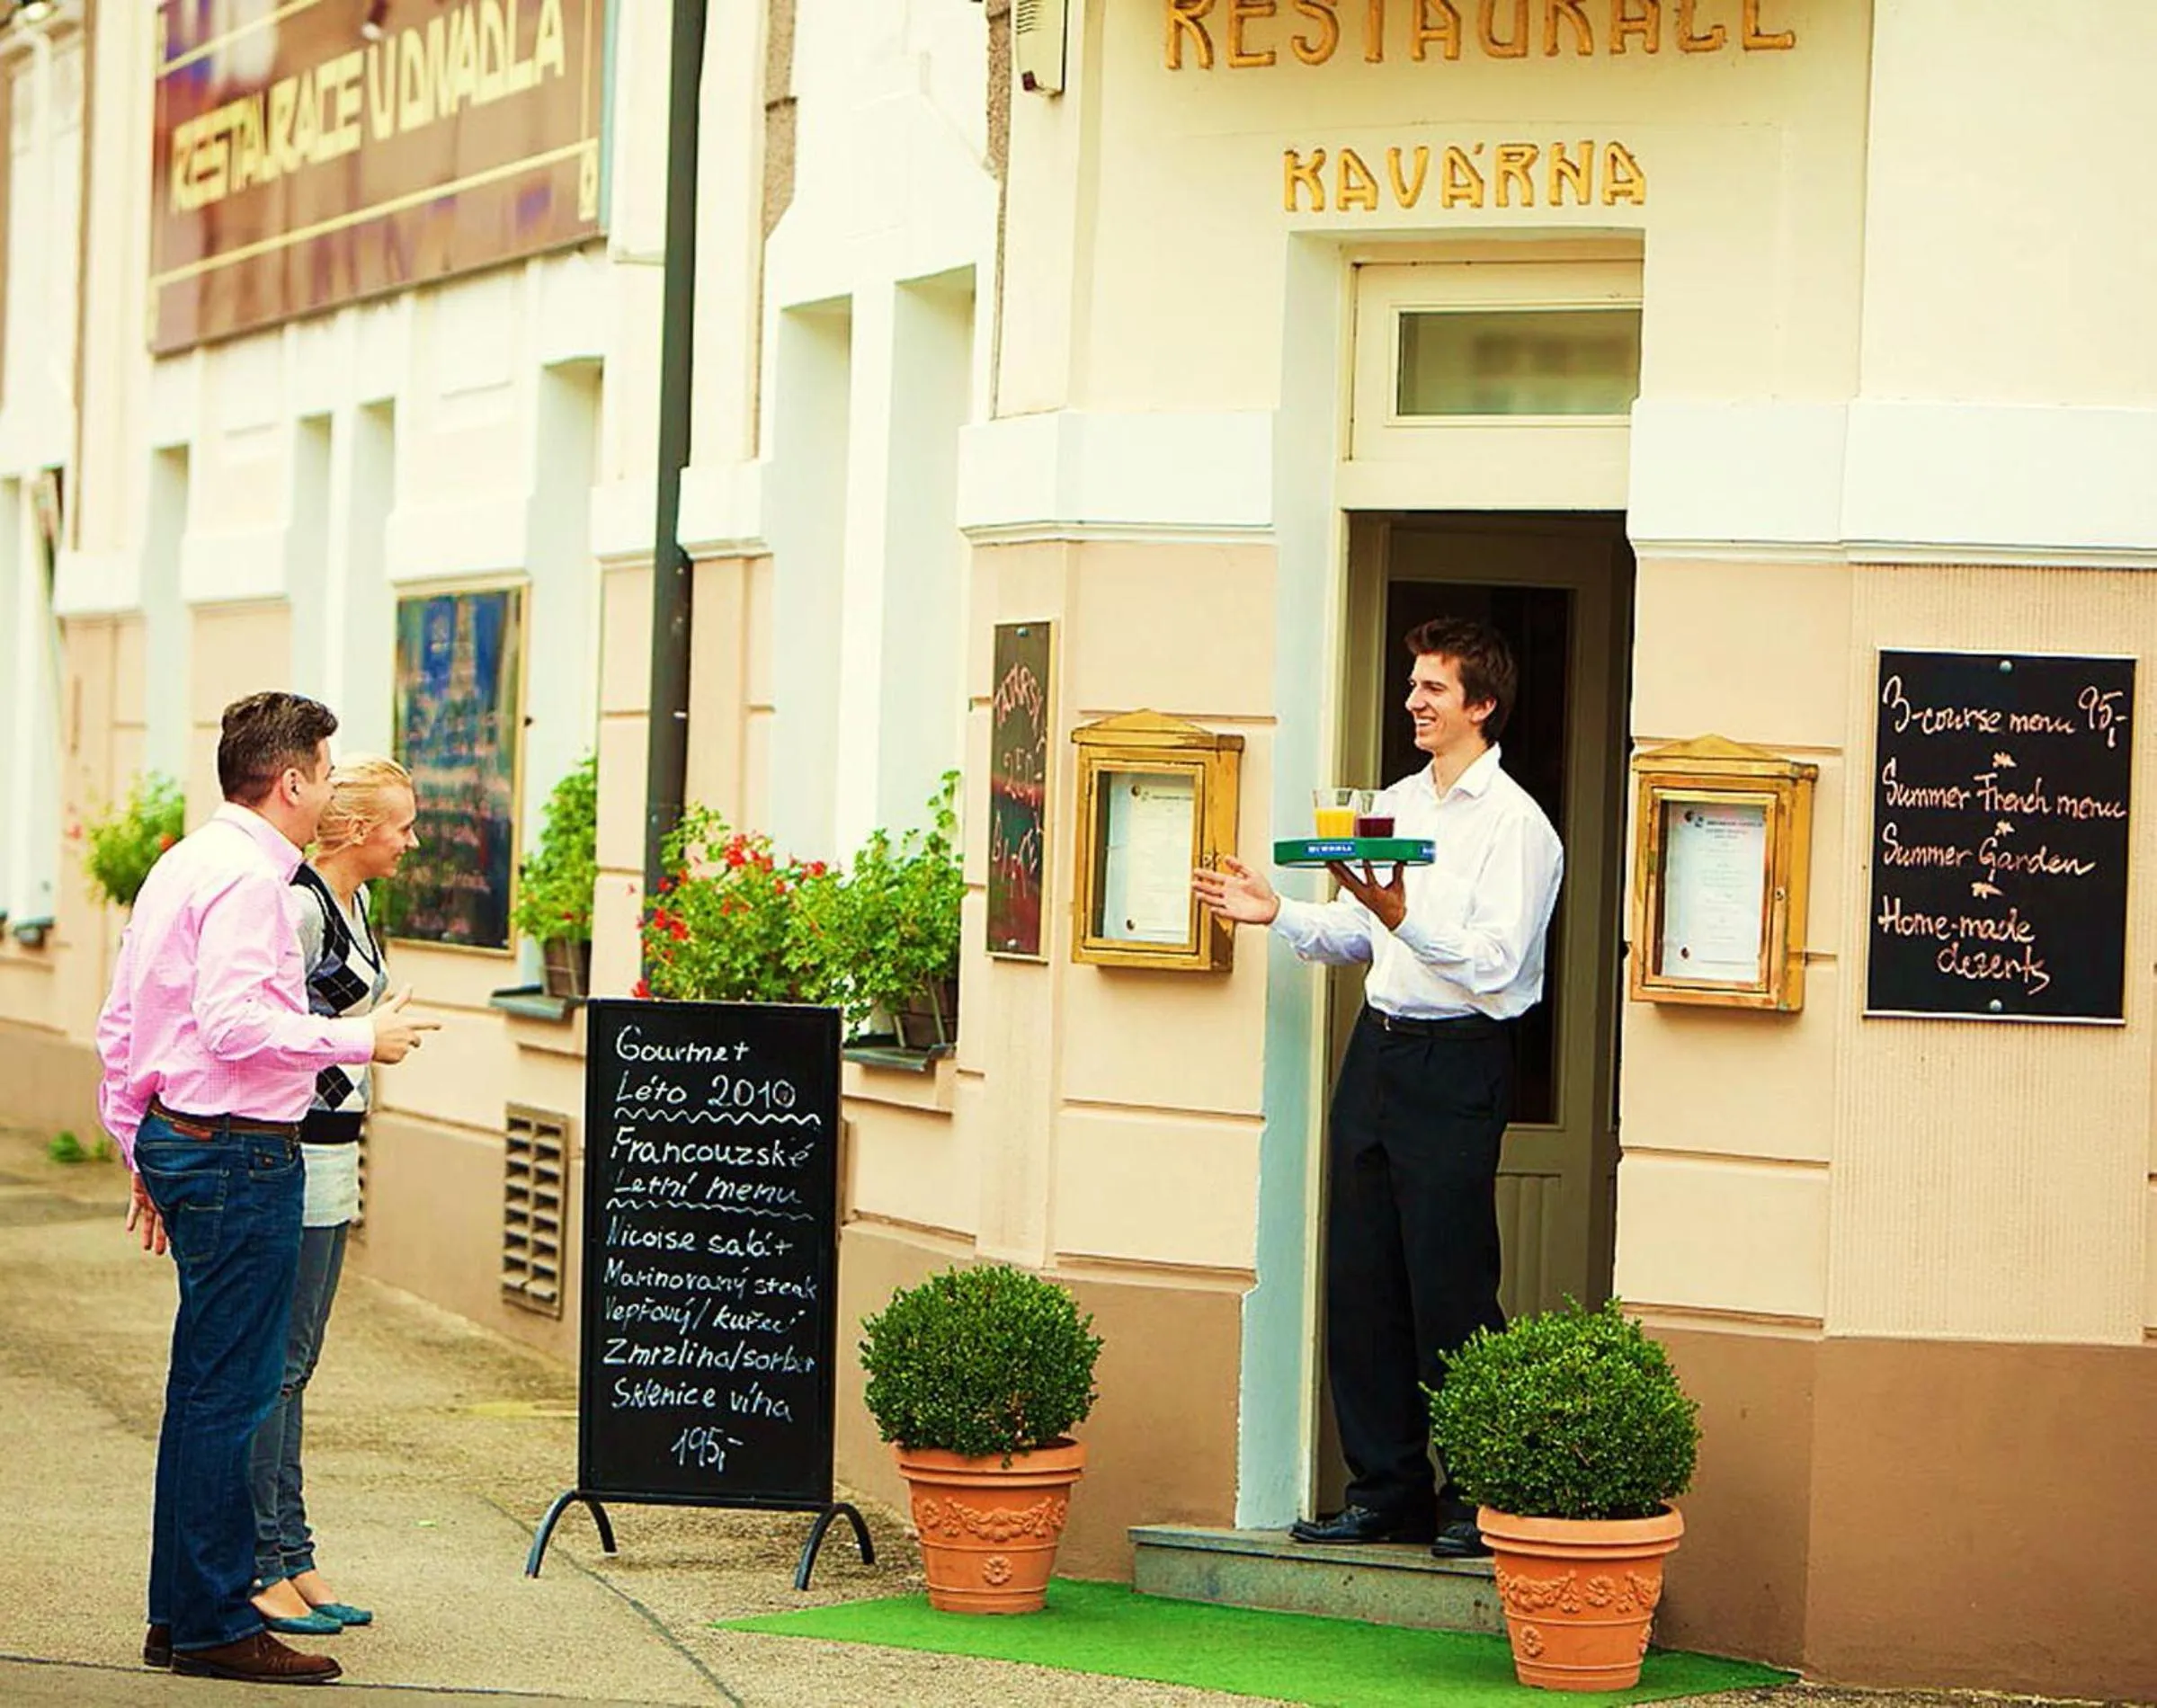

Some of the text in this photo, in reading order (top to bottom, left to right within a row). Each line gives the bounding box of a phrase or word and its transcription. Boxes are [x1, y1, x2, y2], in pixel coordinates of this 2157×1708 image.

[1283, 139, 1647, 212] KAVÁRNA
[1883, 675, 2001, 734] 3-course
[2009, 713, 2075, 734] menu
[1882, 756, 2126, 820] Summer French menu
[1883, 822, 2095, 882] Summer Garden
[1877, 894, 2036, 944] Home-made
[615, 1024, 750, 1063] Gourmet
[615, 1070, 796, 1109] Léto 2010
[611, 1125, 815, 1168] Francouzské
[705, 1177, 802, 1205] menu
[753, 1275, 817, 1303] steak
[611, 1377, 794, 1423] Sklenice vína
